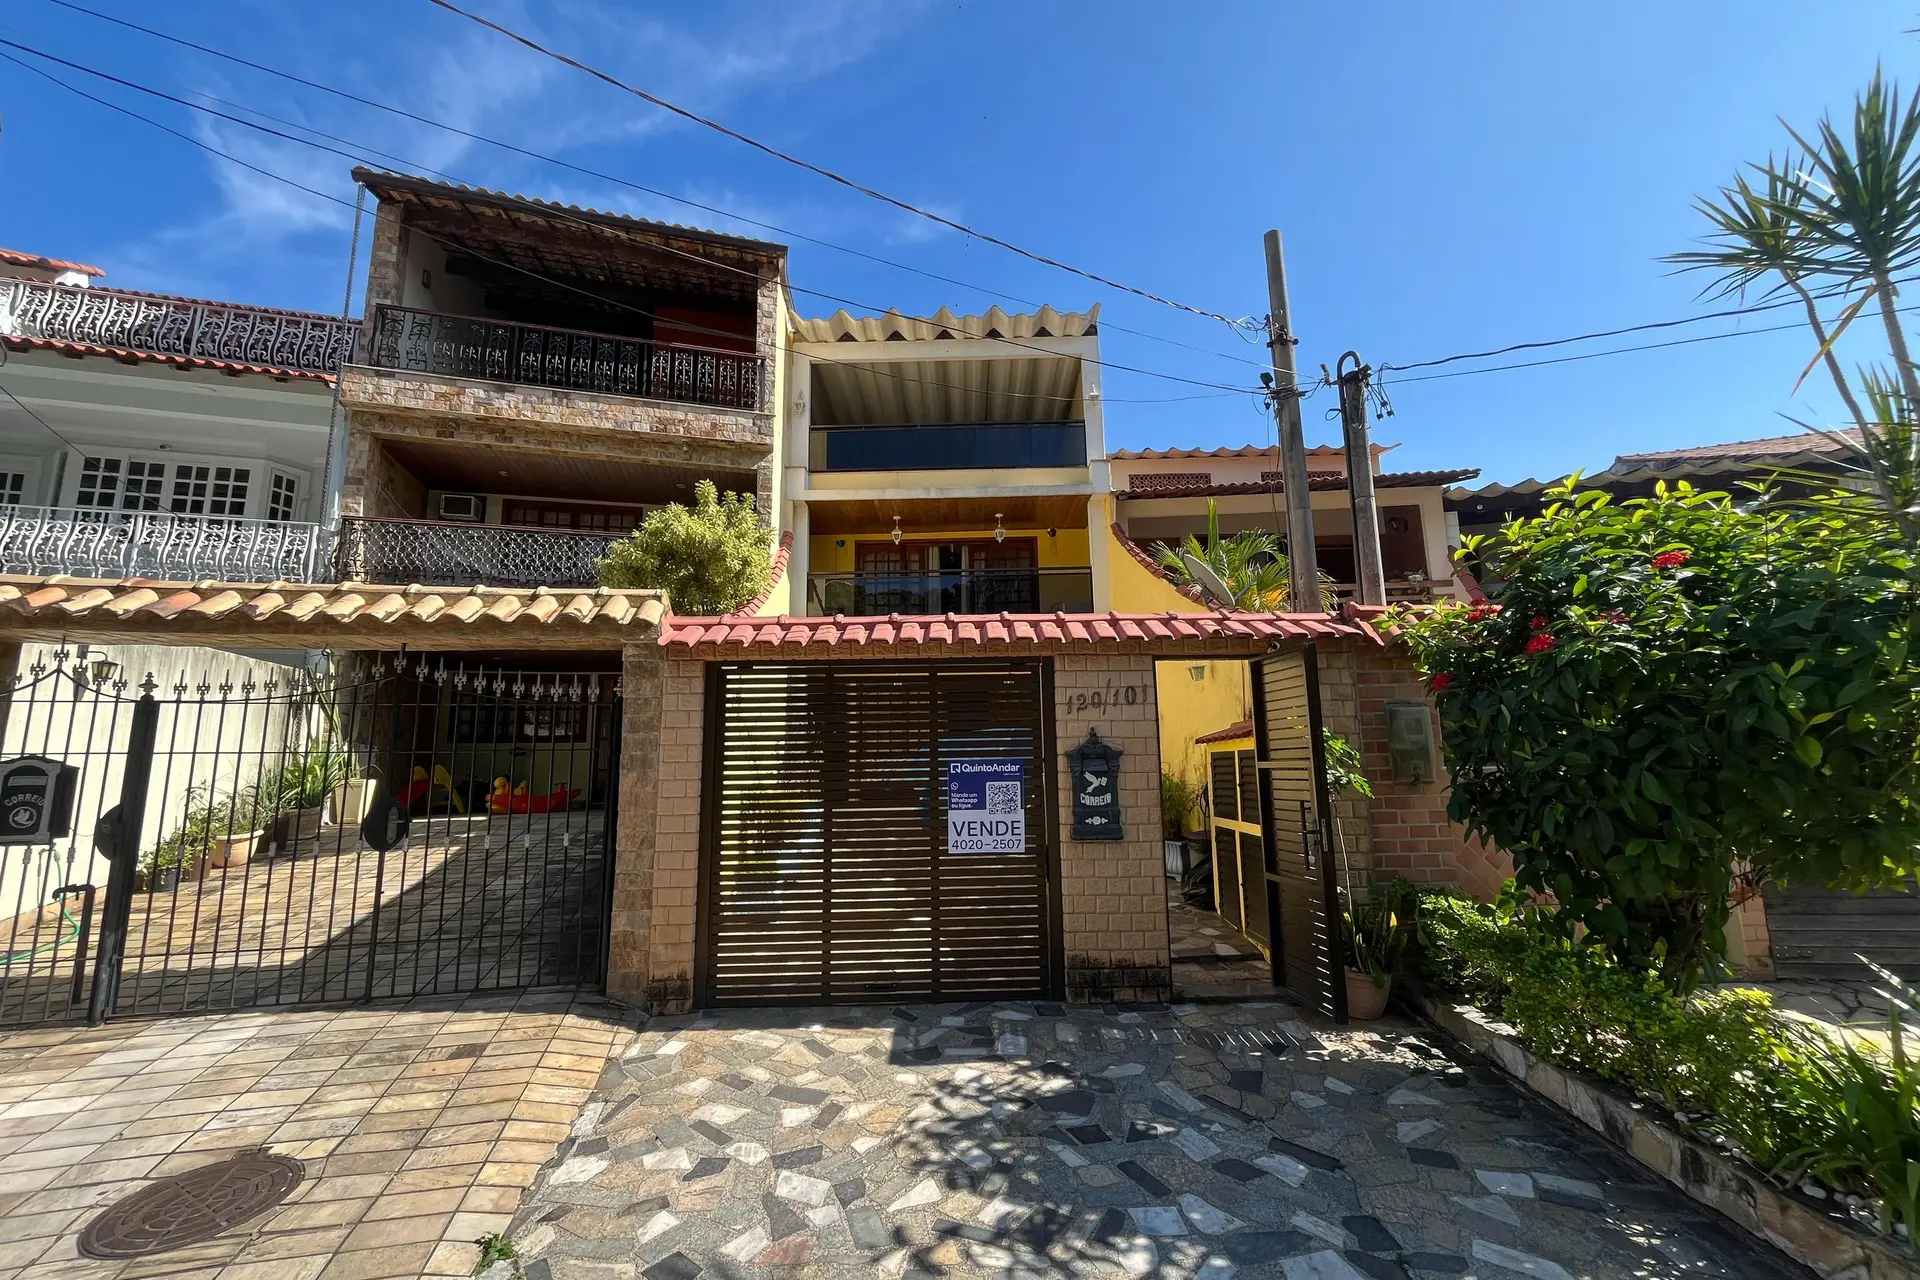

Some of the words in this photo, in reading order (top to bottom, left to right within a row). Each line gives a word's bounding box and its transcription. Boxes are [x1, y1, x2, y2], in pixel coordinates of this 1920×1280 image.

[962, 763, 1021, 773] QuintoAndar
[1080, 792, 1112, 806] CORREIO
[952, 820, 1022, 837] VENDE
[952, 839, 1022, 850] 4020-2507
